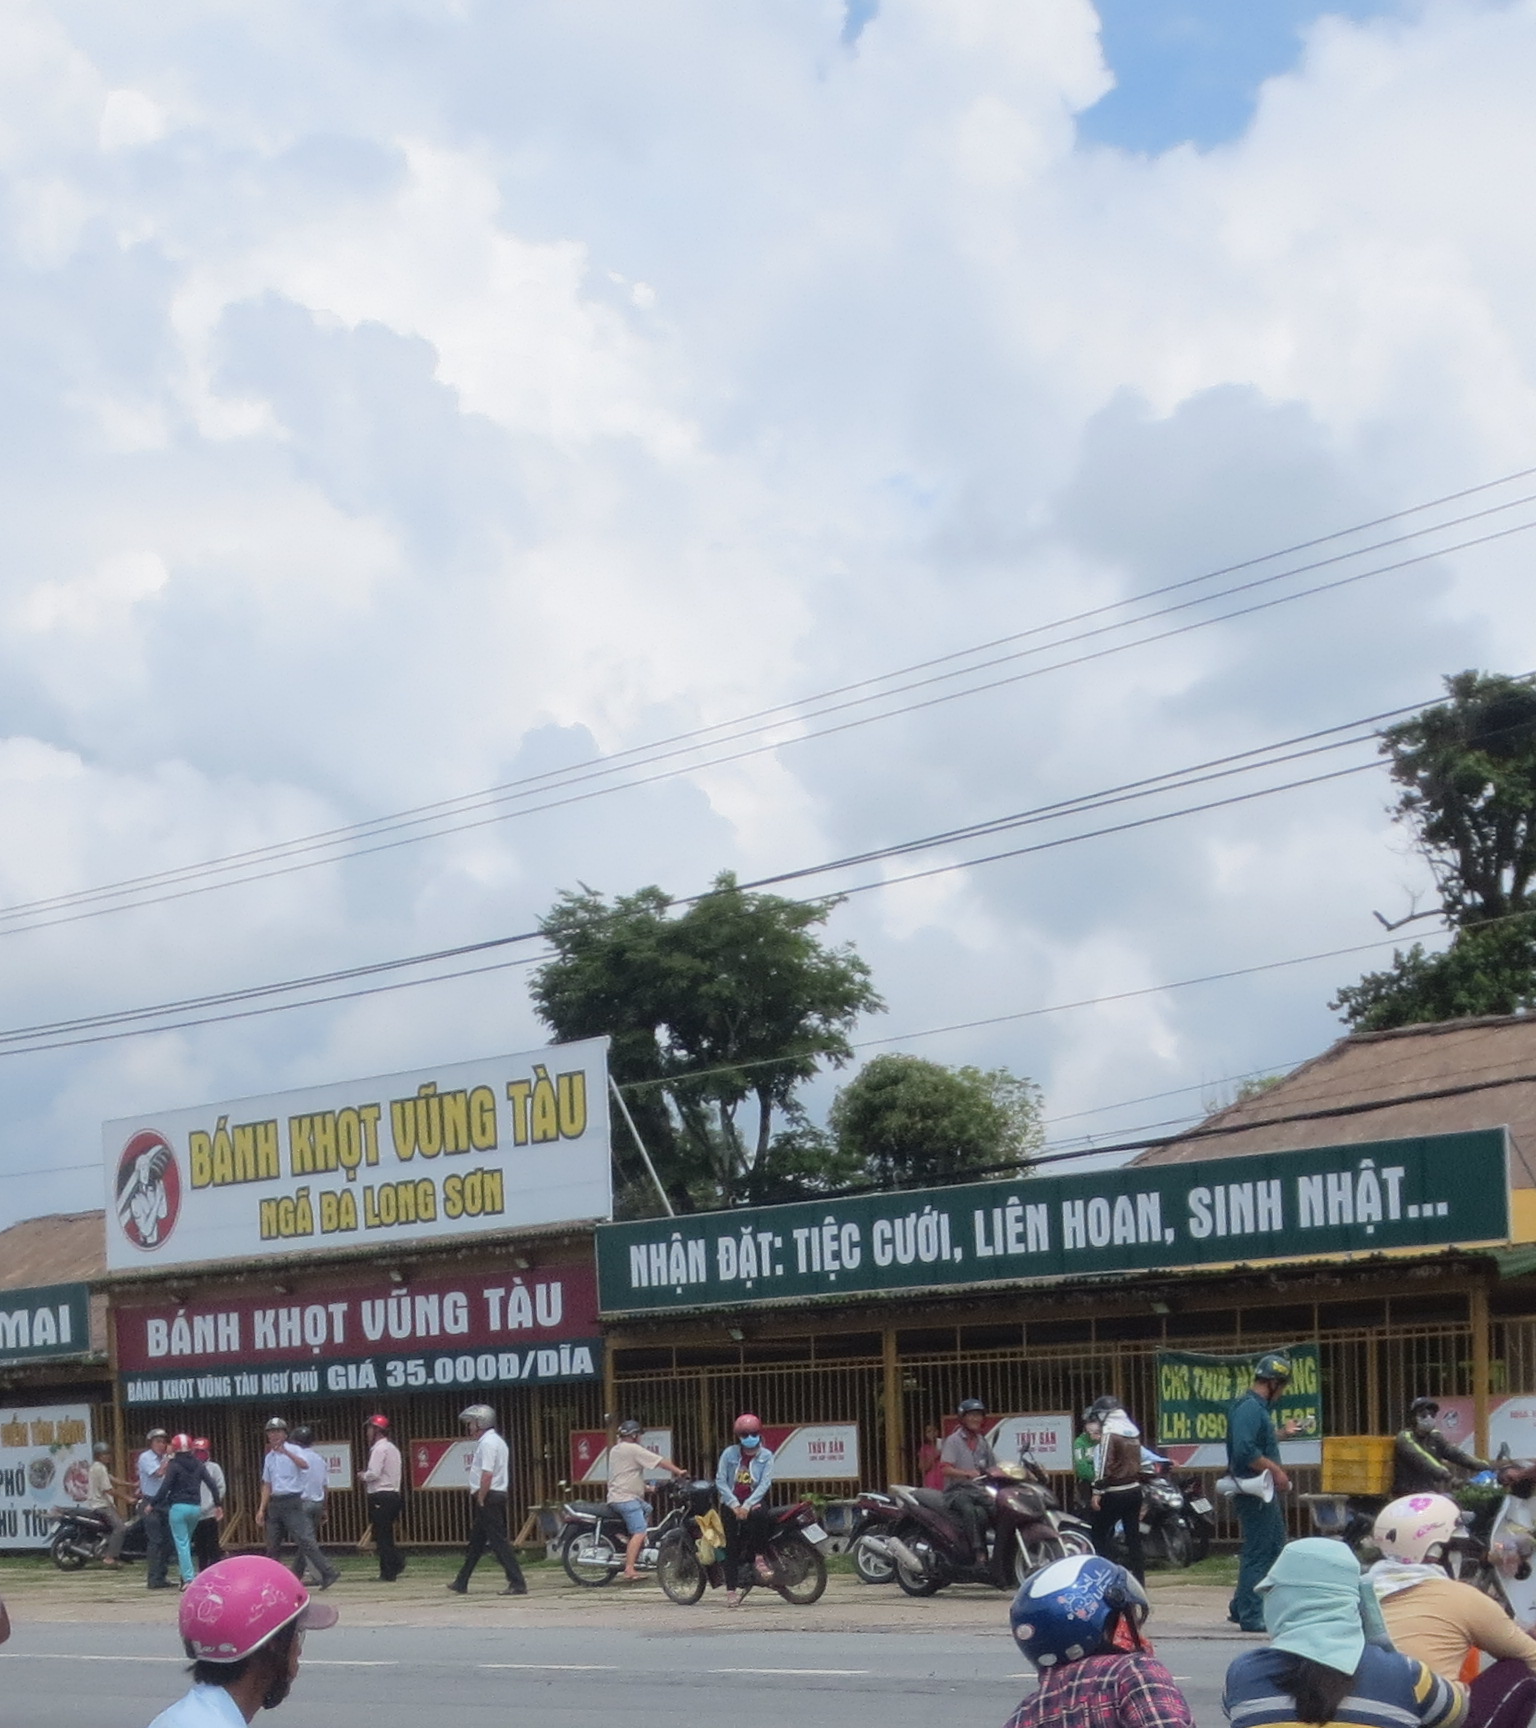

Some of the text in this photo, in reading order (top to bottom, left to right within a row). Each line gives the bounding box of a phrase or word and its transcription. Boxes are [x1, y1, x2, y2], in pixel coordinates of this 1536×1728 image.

[188, 1064, 587, 1190] BÁNH KHỌT VŨNG TÀU
[259, 1168, 505, 1240] NGÃ BA LONG SƠN
[629, 1158, 1449, 1294] NHẬN ĐẶT: TIỆC CƯỚI, LIÊN HOAN, SINH NHẬT...
[147, 1276, 562, 1358] BÁNH KHỌT VŨNG TÀU
[127, 1378, 160, 1402] BÁNH
[162, 1378, 195, 1402] KHỌT
[197, 1374, 231, 1398] VŨNG
[234, 1372, 259, 1396] TÀU
[327, 1359, 378, 1391] GIÁ
[1163, 1412, 1191, 1439] LH:
